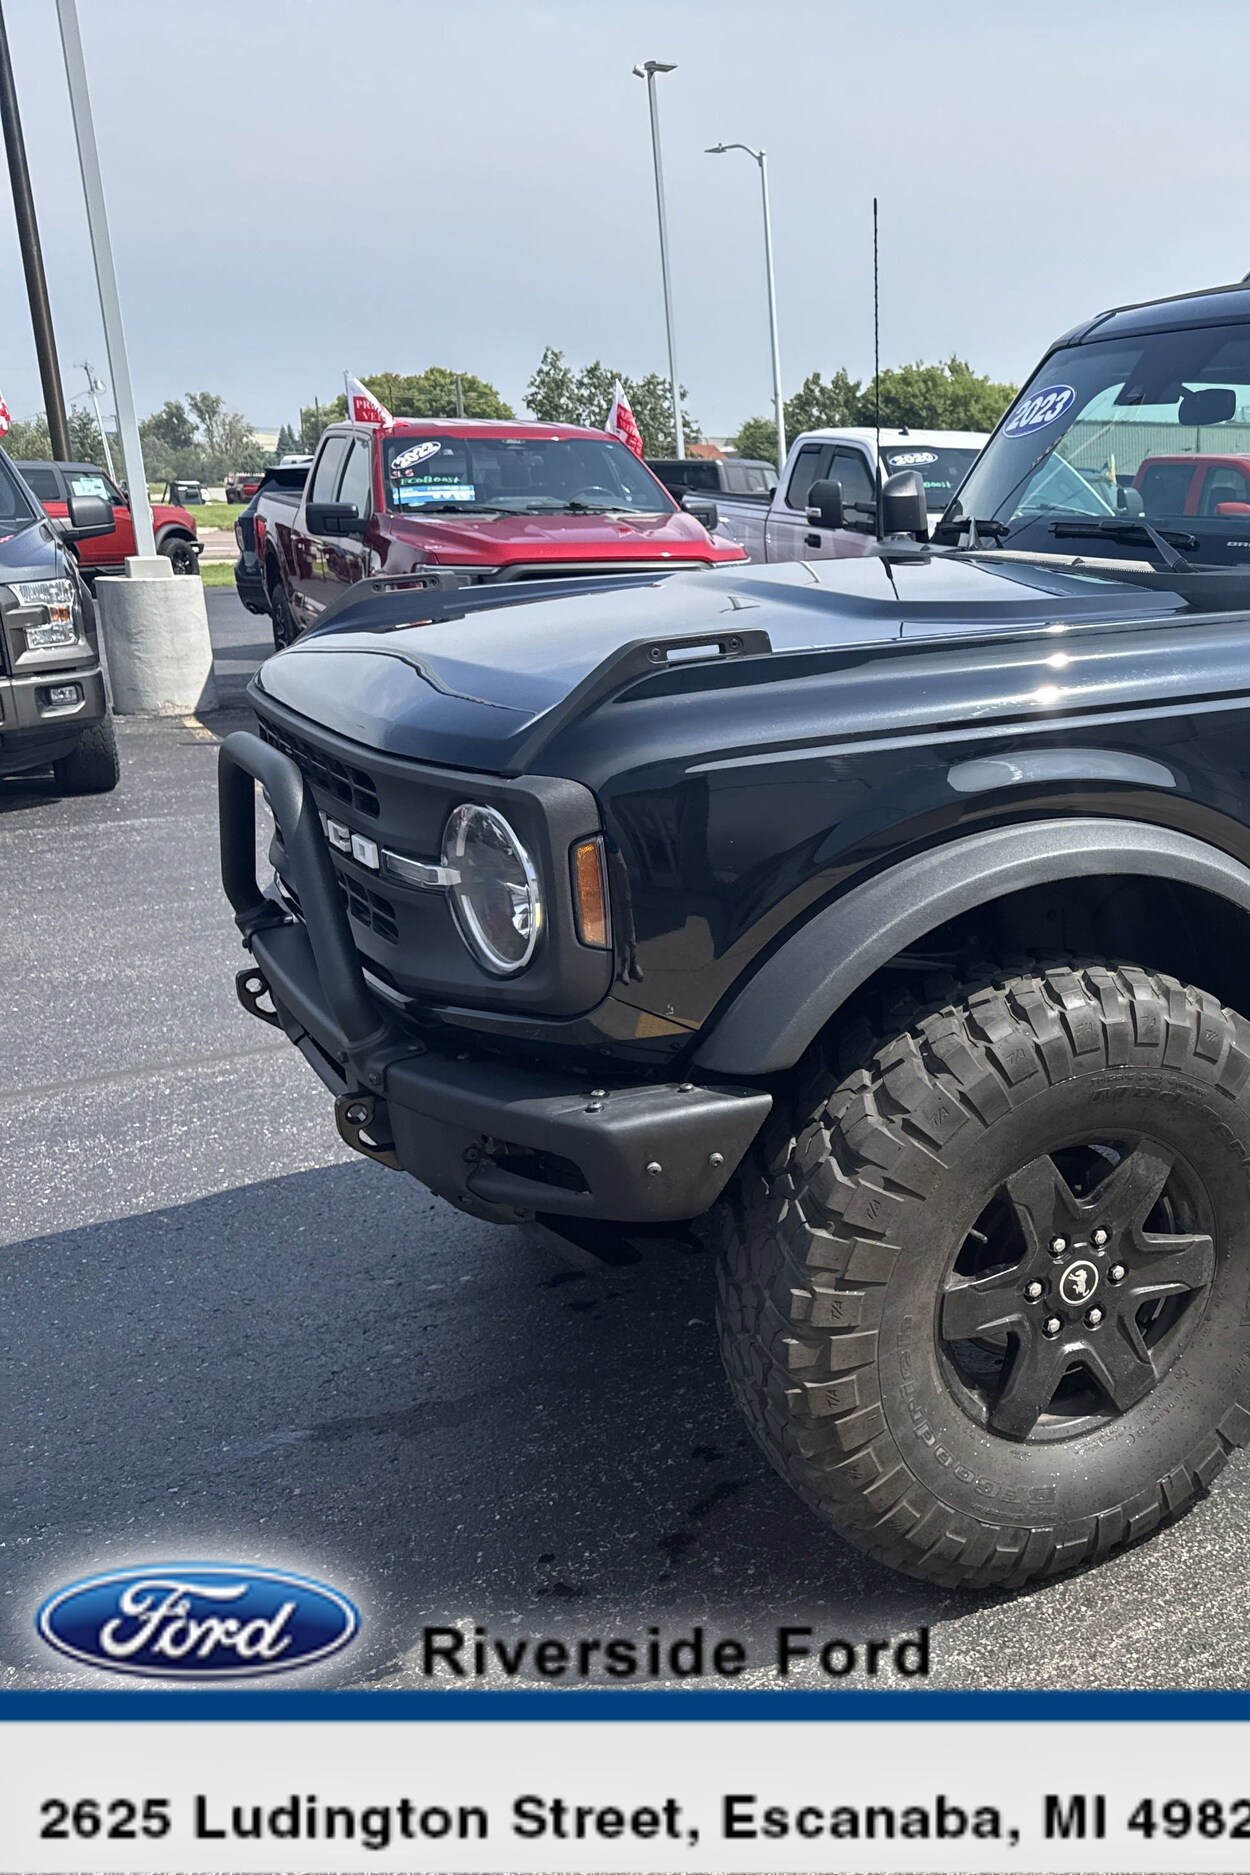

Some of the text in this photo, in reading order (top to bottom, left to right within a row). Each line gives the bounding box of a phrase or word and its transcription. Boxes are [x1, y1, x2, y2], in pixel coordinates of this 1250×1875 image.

[1005, 389, 1071, 432] 2023
[396, 442, 439, 468] 2022
[894, 452, 934, 465] 2020
